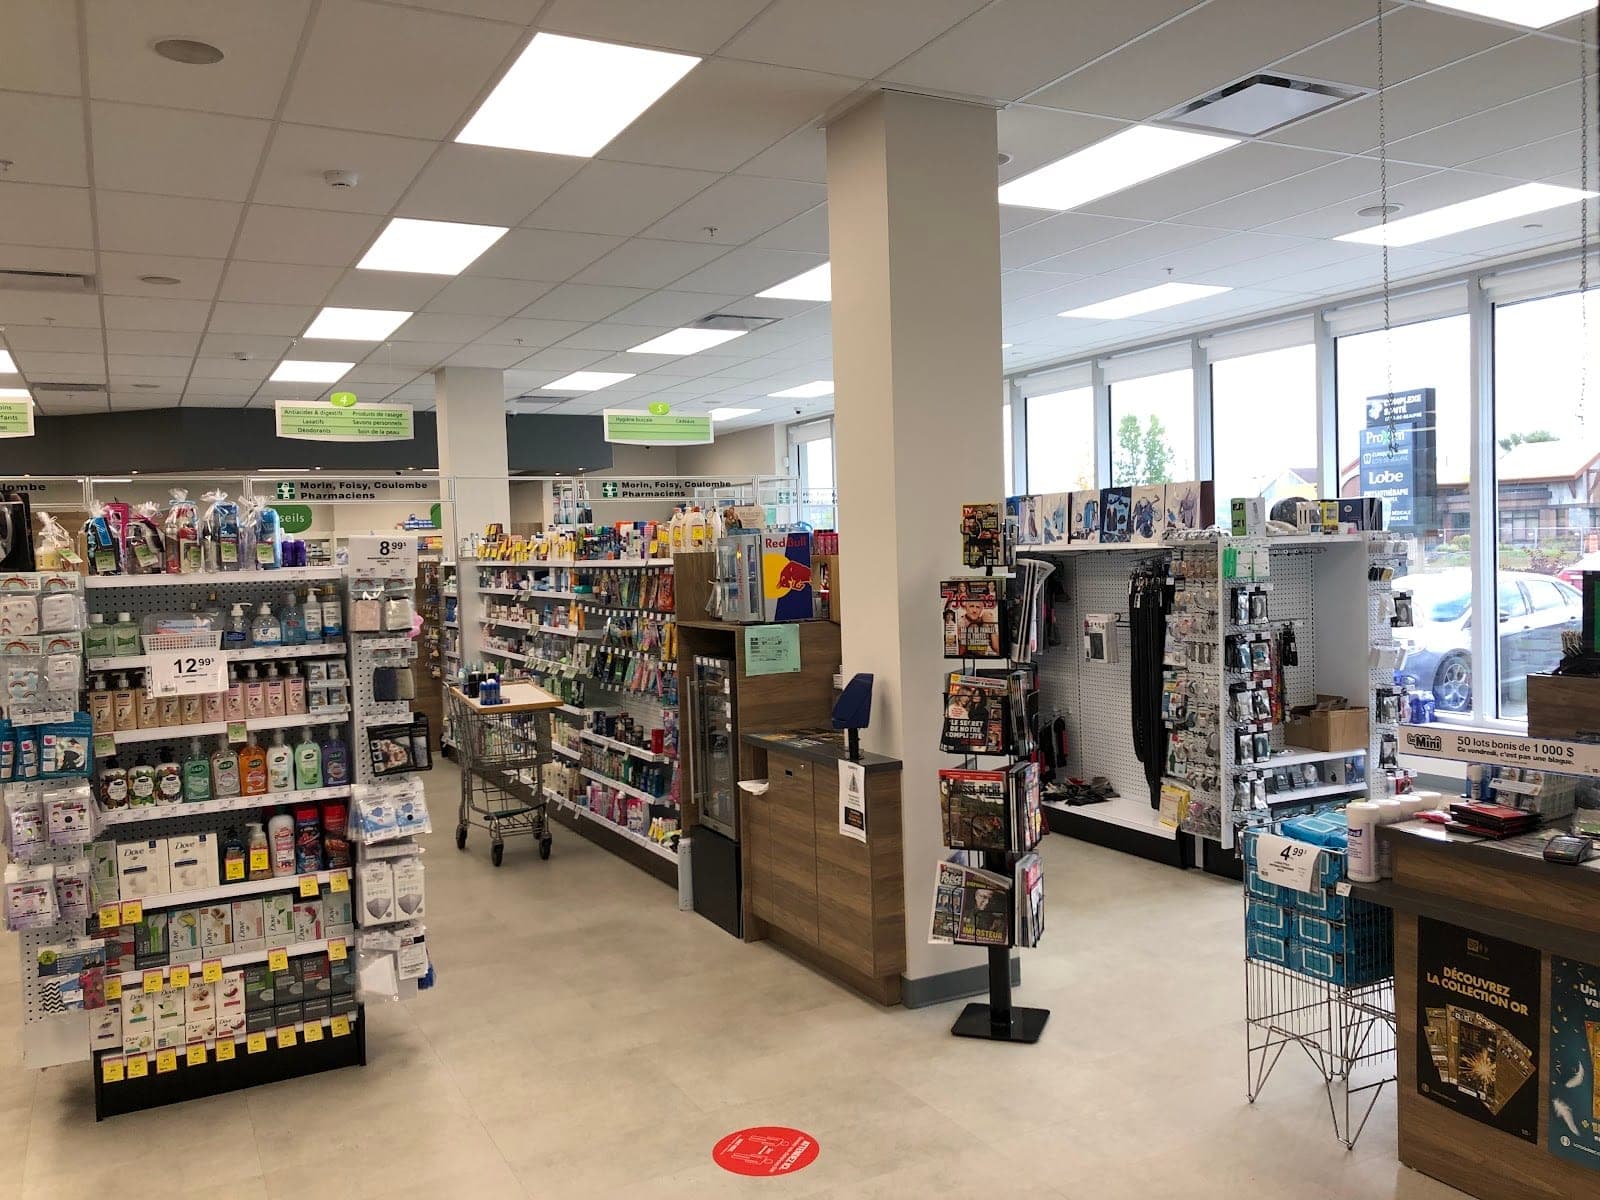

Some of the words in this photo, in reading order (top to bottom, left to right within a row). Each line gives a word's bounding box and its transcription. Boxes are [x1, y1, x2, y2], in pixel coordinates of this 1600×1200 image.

[340, 395, 348, 404] 4
[656, 404, 662, 413] 5
[1368, 471, 1404, 484] Lobe
[300, 481, 336, 490] Morin,
[339, 481, 371, 491] Foisy,
[374, 481, 428, 489] Coulombe
[621, 481, 653, 489] Morin,
[655, 481, 682, 490] Foisy,
[280, 513, 305, 523] seils
[765, 538, 786, 548] Red
[786, 538, 807, 548] Bull
[1416, 735, 1442, 750] Mini
[1457, 736, 1471, 746] 50
[1473, 738, 1490, 748] lots
[1492, 739, 1517, 751] bonis
[1518, 742, 1531, 752] de
[1541, 745, 1563, 756] 000
[1467, 747, 1498, 757] vendredi,
[1499, 751, 1517, 759] c'est
[1548, 757, 1575, 766] blague.
[175, 841, 195, 850] Dove
[123, 848, 145, 857] Dove
[962, 927, 1003, 939] IMOSTEUR
[1443, 966, 1511, 997] DÉCOUVREZ
[1426, 972, 1440, 986] LA
[1441, 977, 1509, 1009] COLLECTION
[1510, 1001, 1529, 1016] OR
[1580, 983, 1597, 996] Un
